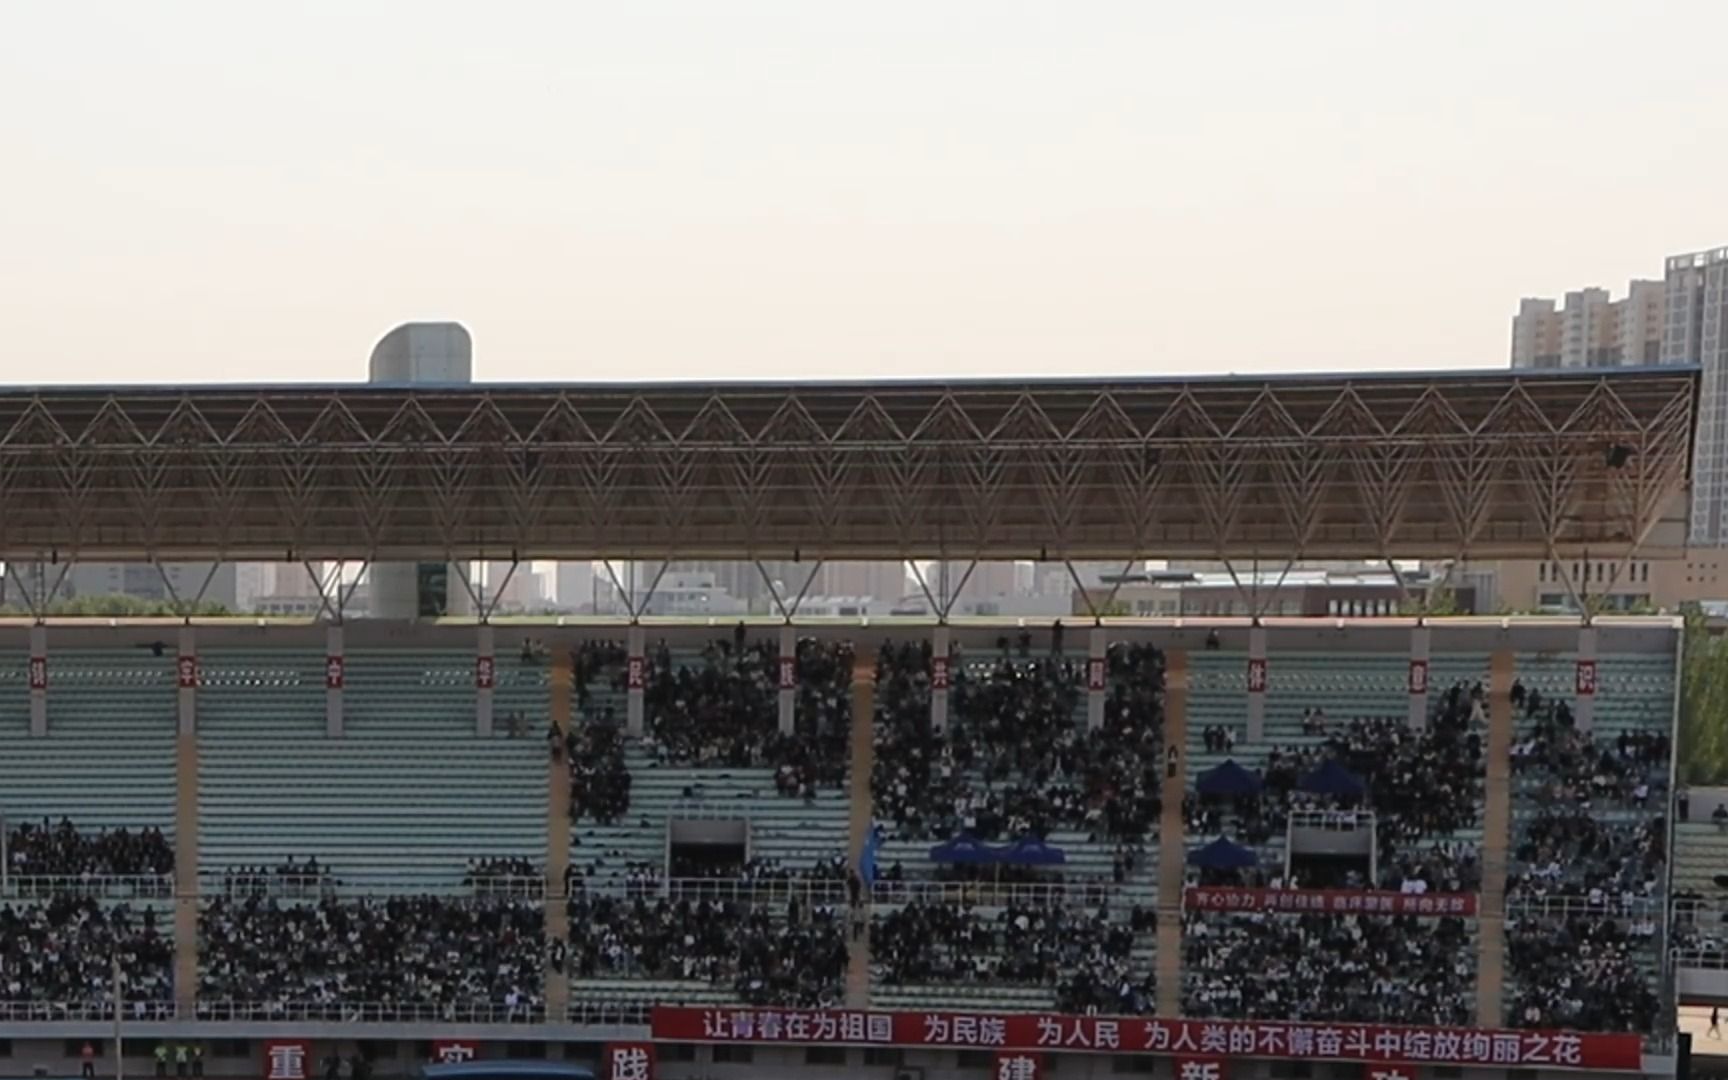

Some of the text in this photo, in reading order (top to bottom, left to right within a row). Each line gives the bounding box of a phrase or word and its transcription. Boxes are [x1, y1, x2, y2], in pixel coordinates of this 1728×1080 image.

[703, 1011, 1582, 1065] 让青春在为祖国 为民族 为人民 为人类的不懈奋斗中绽放绚丽之花
[269, 1045, 305, 1080] 重
